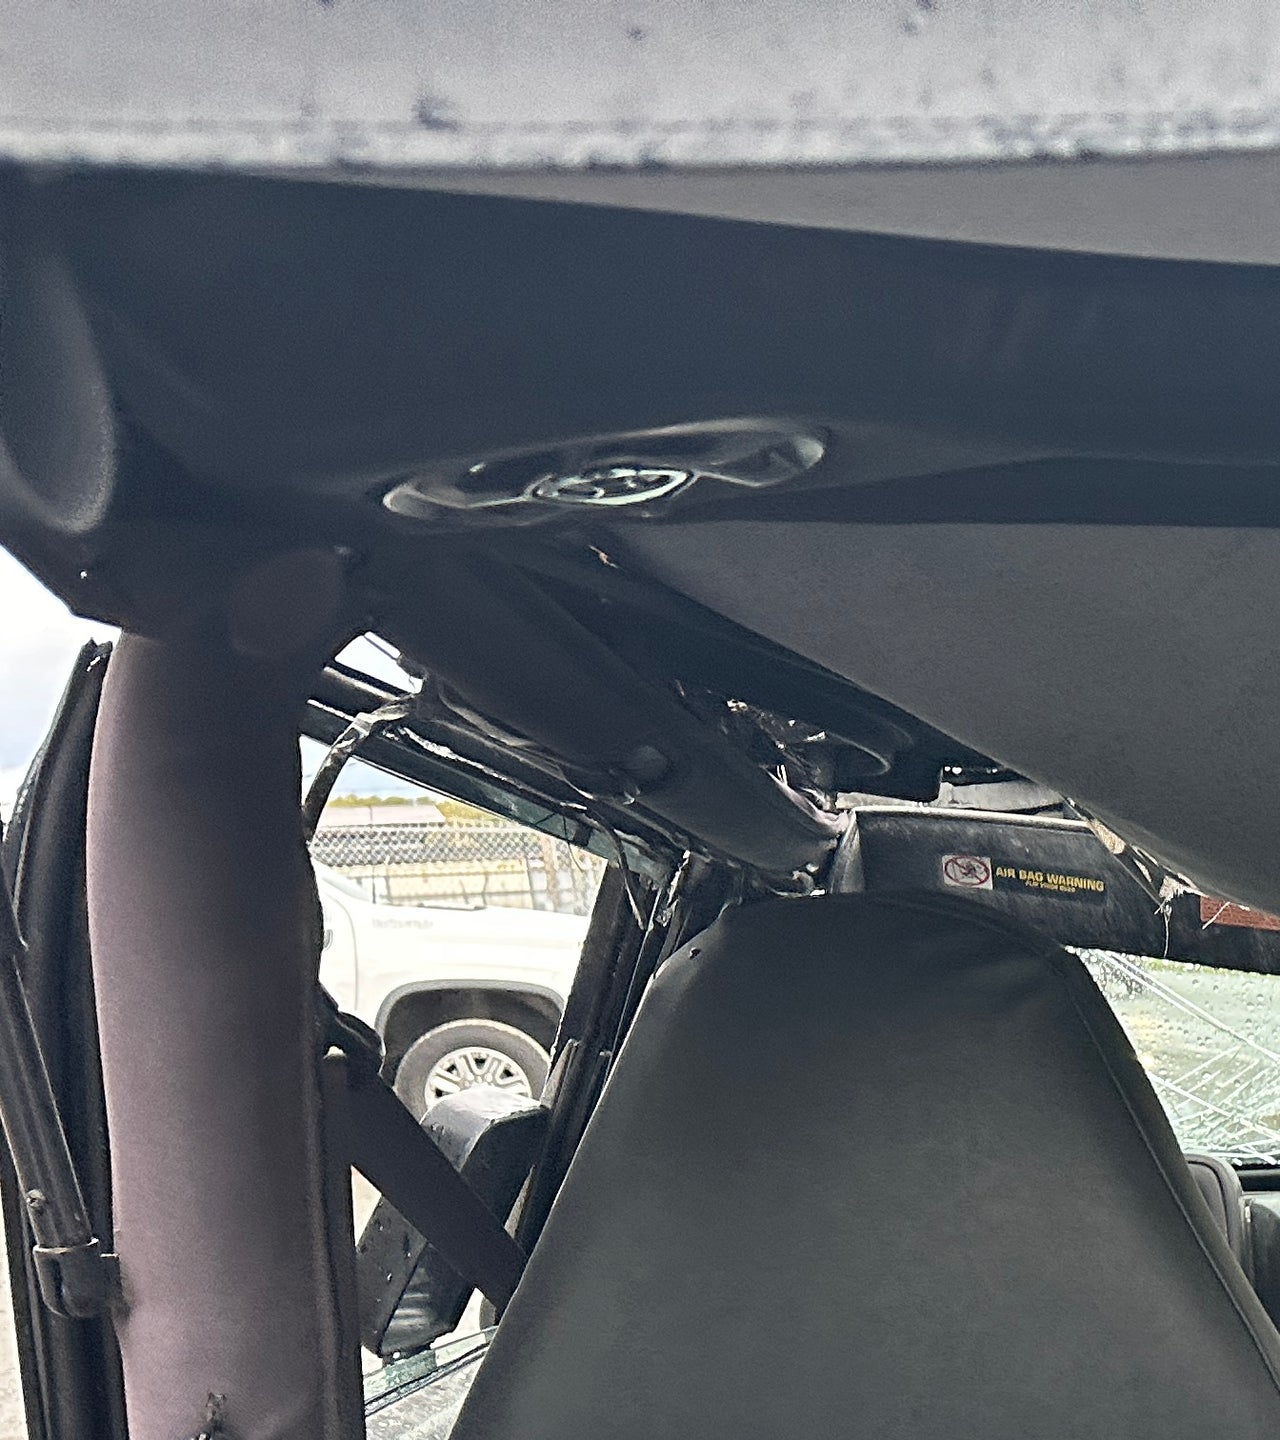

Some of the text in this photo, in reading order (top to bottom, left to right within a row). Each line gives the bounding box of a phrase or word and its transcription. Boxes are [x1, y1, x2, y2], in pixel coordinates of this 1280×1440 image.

[995, 867, 1105, 892] AIR BAG WARNING
